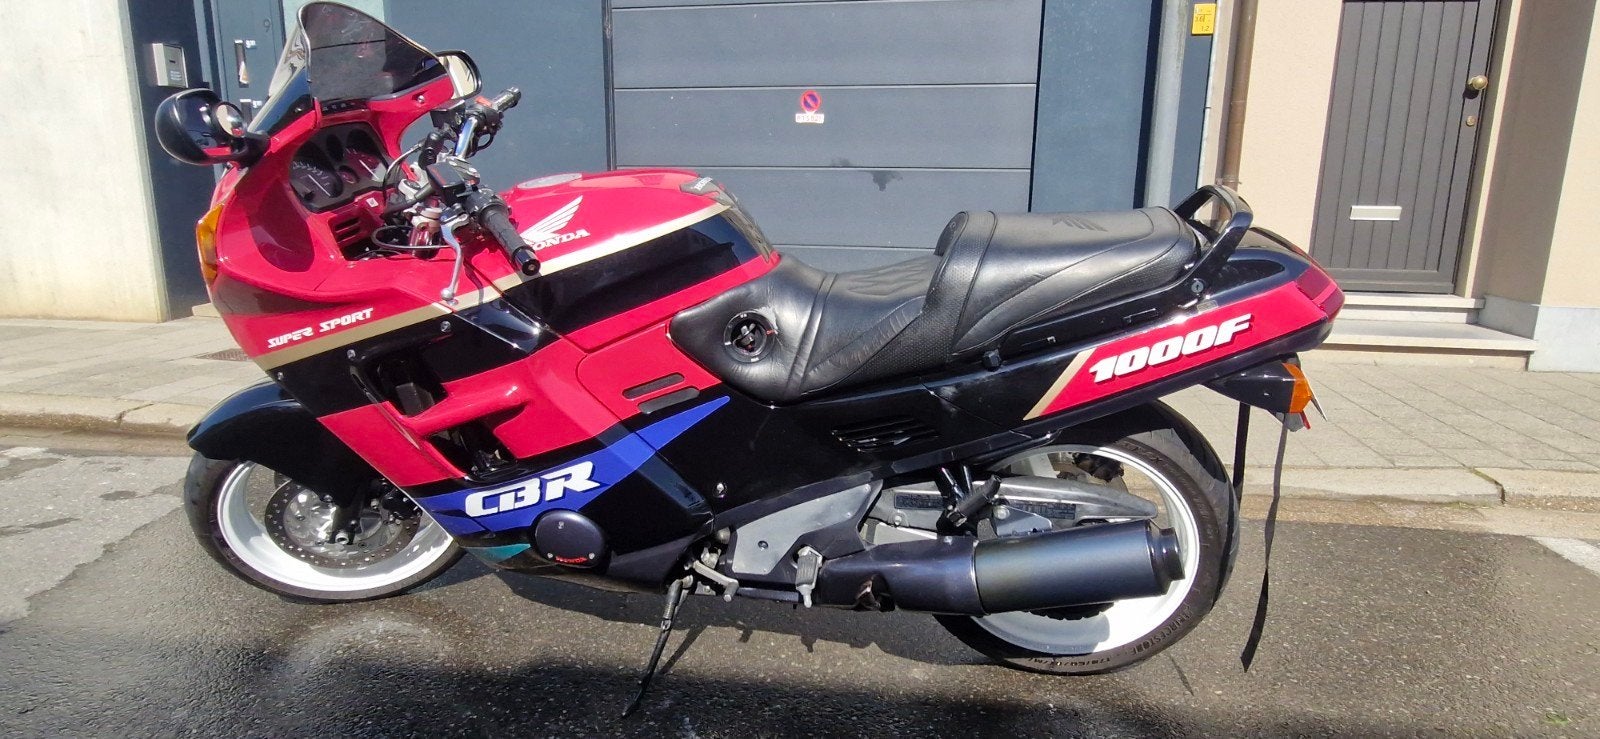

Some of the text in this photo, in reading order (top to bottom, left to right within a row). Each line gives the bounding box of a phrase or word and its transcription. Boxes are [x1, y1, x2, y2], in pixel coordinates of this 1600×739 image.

[268, 307, 374, 348] SUPER SPORT
[1089, 313, 1252, 383] 1000F
[465, 461, 601, 517] CBR
